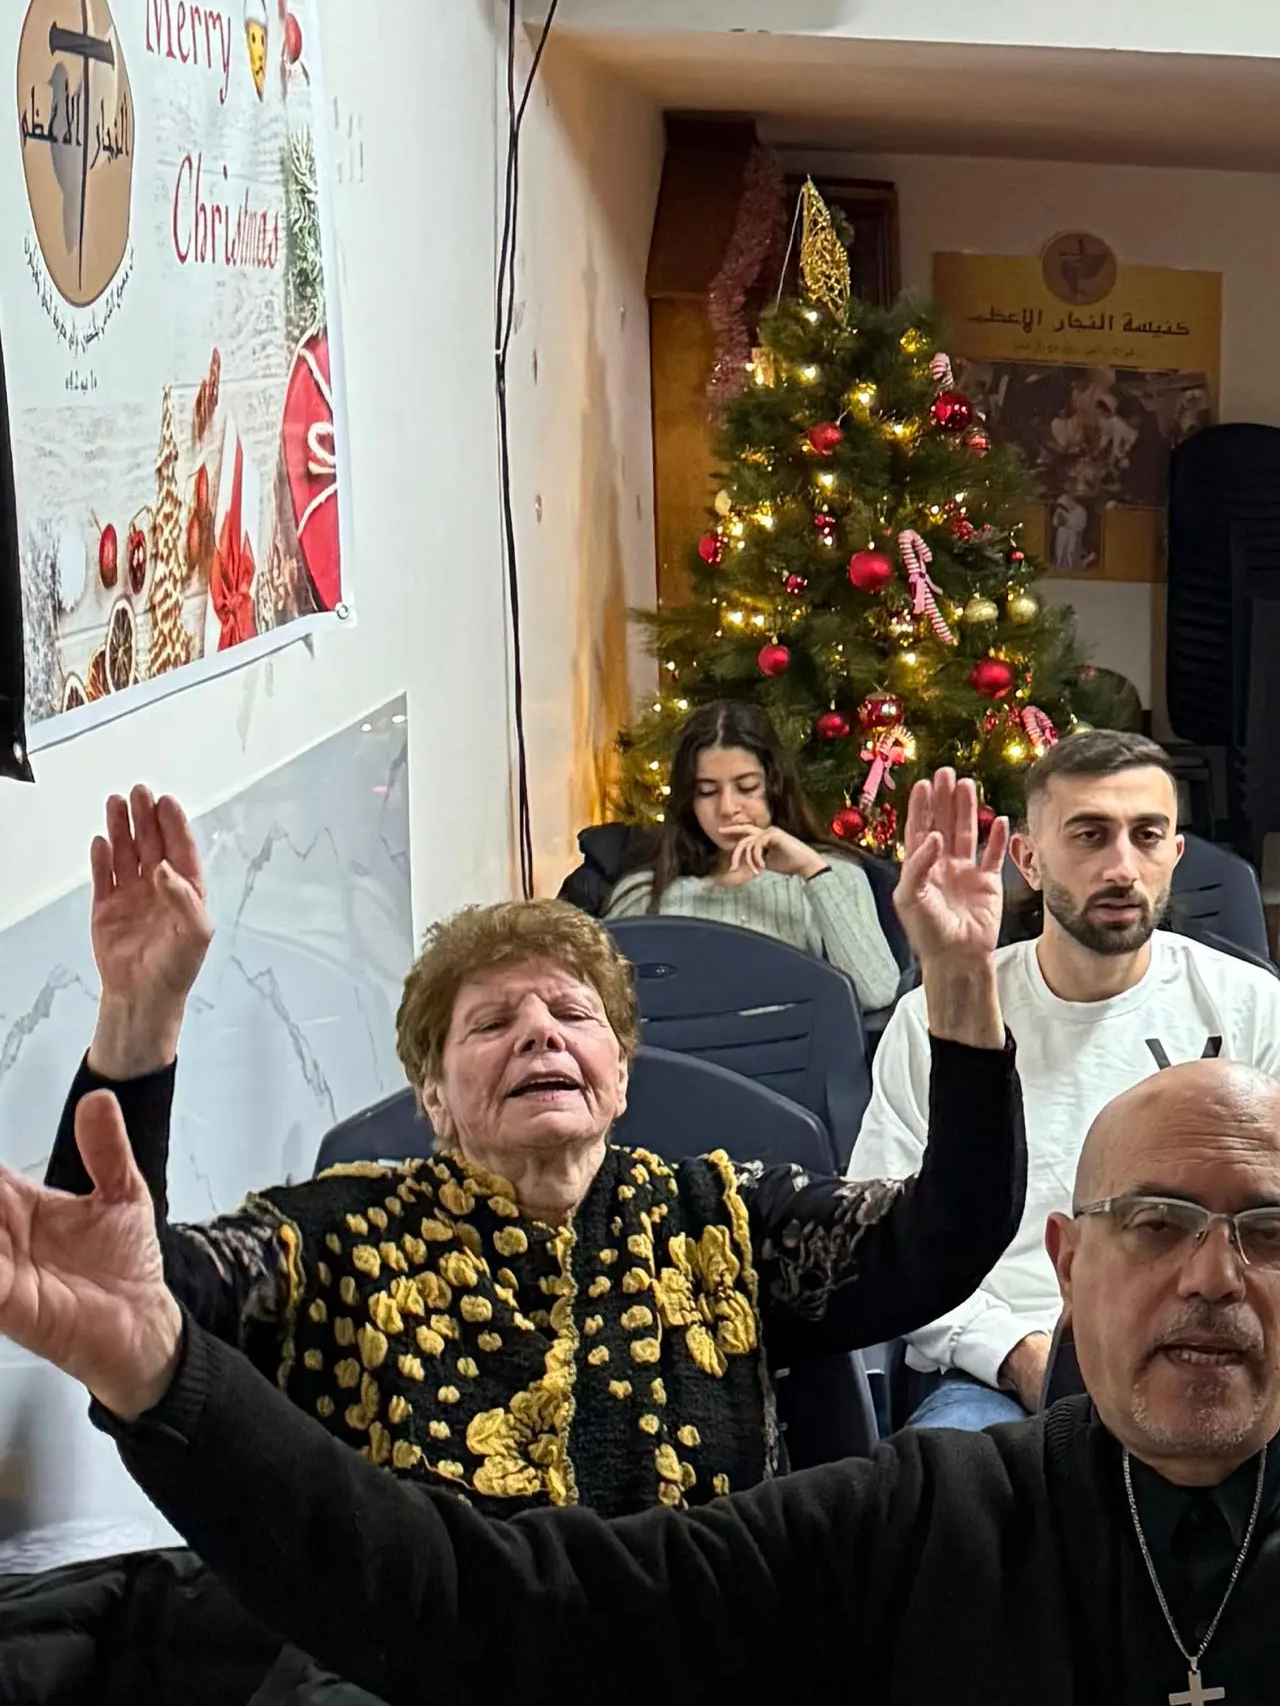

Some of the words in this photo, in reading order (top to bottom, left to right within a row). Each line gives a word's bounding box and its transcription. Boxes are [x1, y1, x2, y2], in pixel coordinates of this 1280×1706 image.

[90, 92, 130, 169] النجار
[173, 153, 280, 269] Christmas
[1053, 309, 1113, 333] النجار
[1122, 312, 1191, 336] كنيسة
